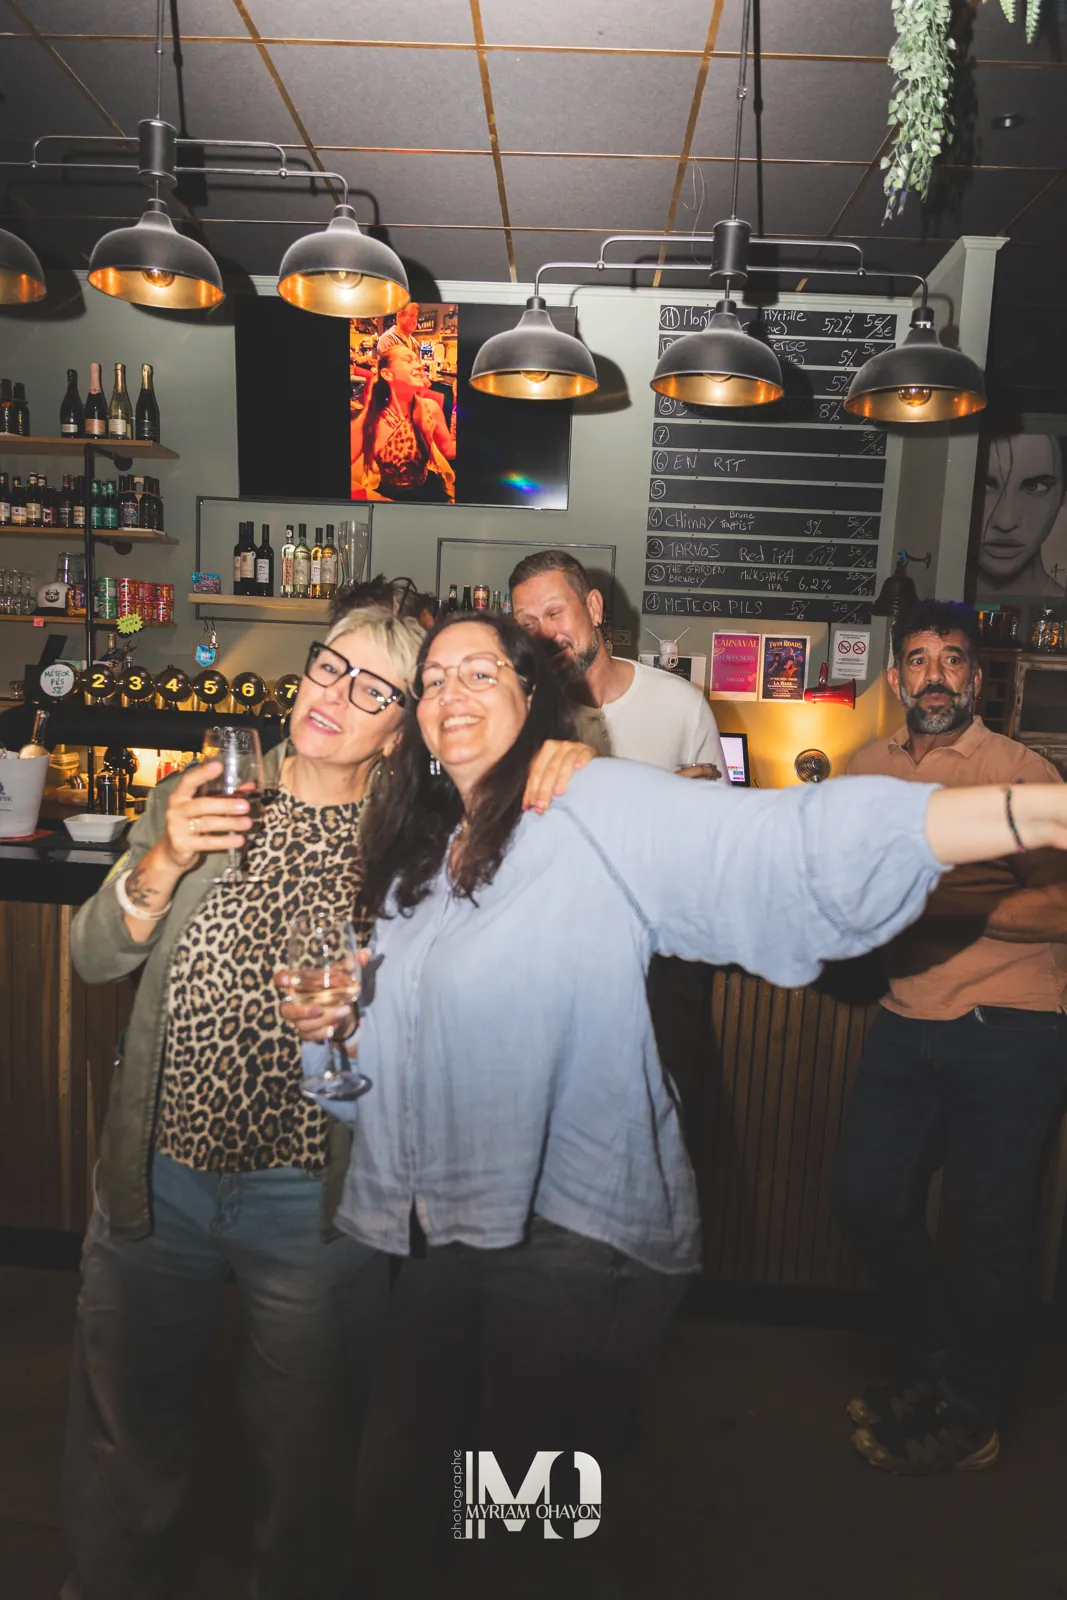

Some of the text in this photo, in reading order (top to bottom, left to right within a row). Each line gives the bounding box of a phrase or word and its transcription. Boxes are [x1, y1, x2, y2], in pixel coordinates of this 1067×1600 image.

[838, 349, 858, 366] 5%
[820, 401, 843, 421] 8%
[673, 454, 697, 470] EN
[803, 519, 822, 536] 9%
[740, 545, 765, 562] Red
[728, 599, 763, 614] PILS
[714, 639, 759, 648] CARNAVAL
[91, 673, 298, 699] 2 3 4 5 6 7
